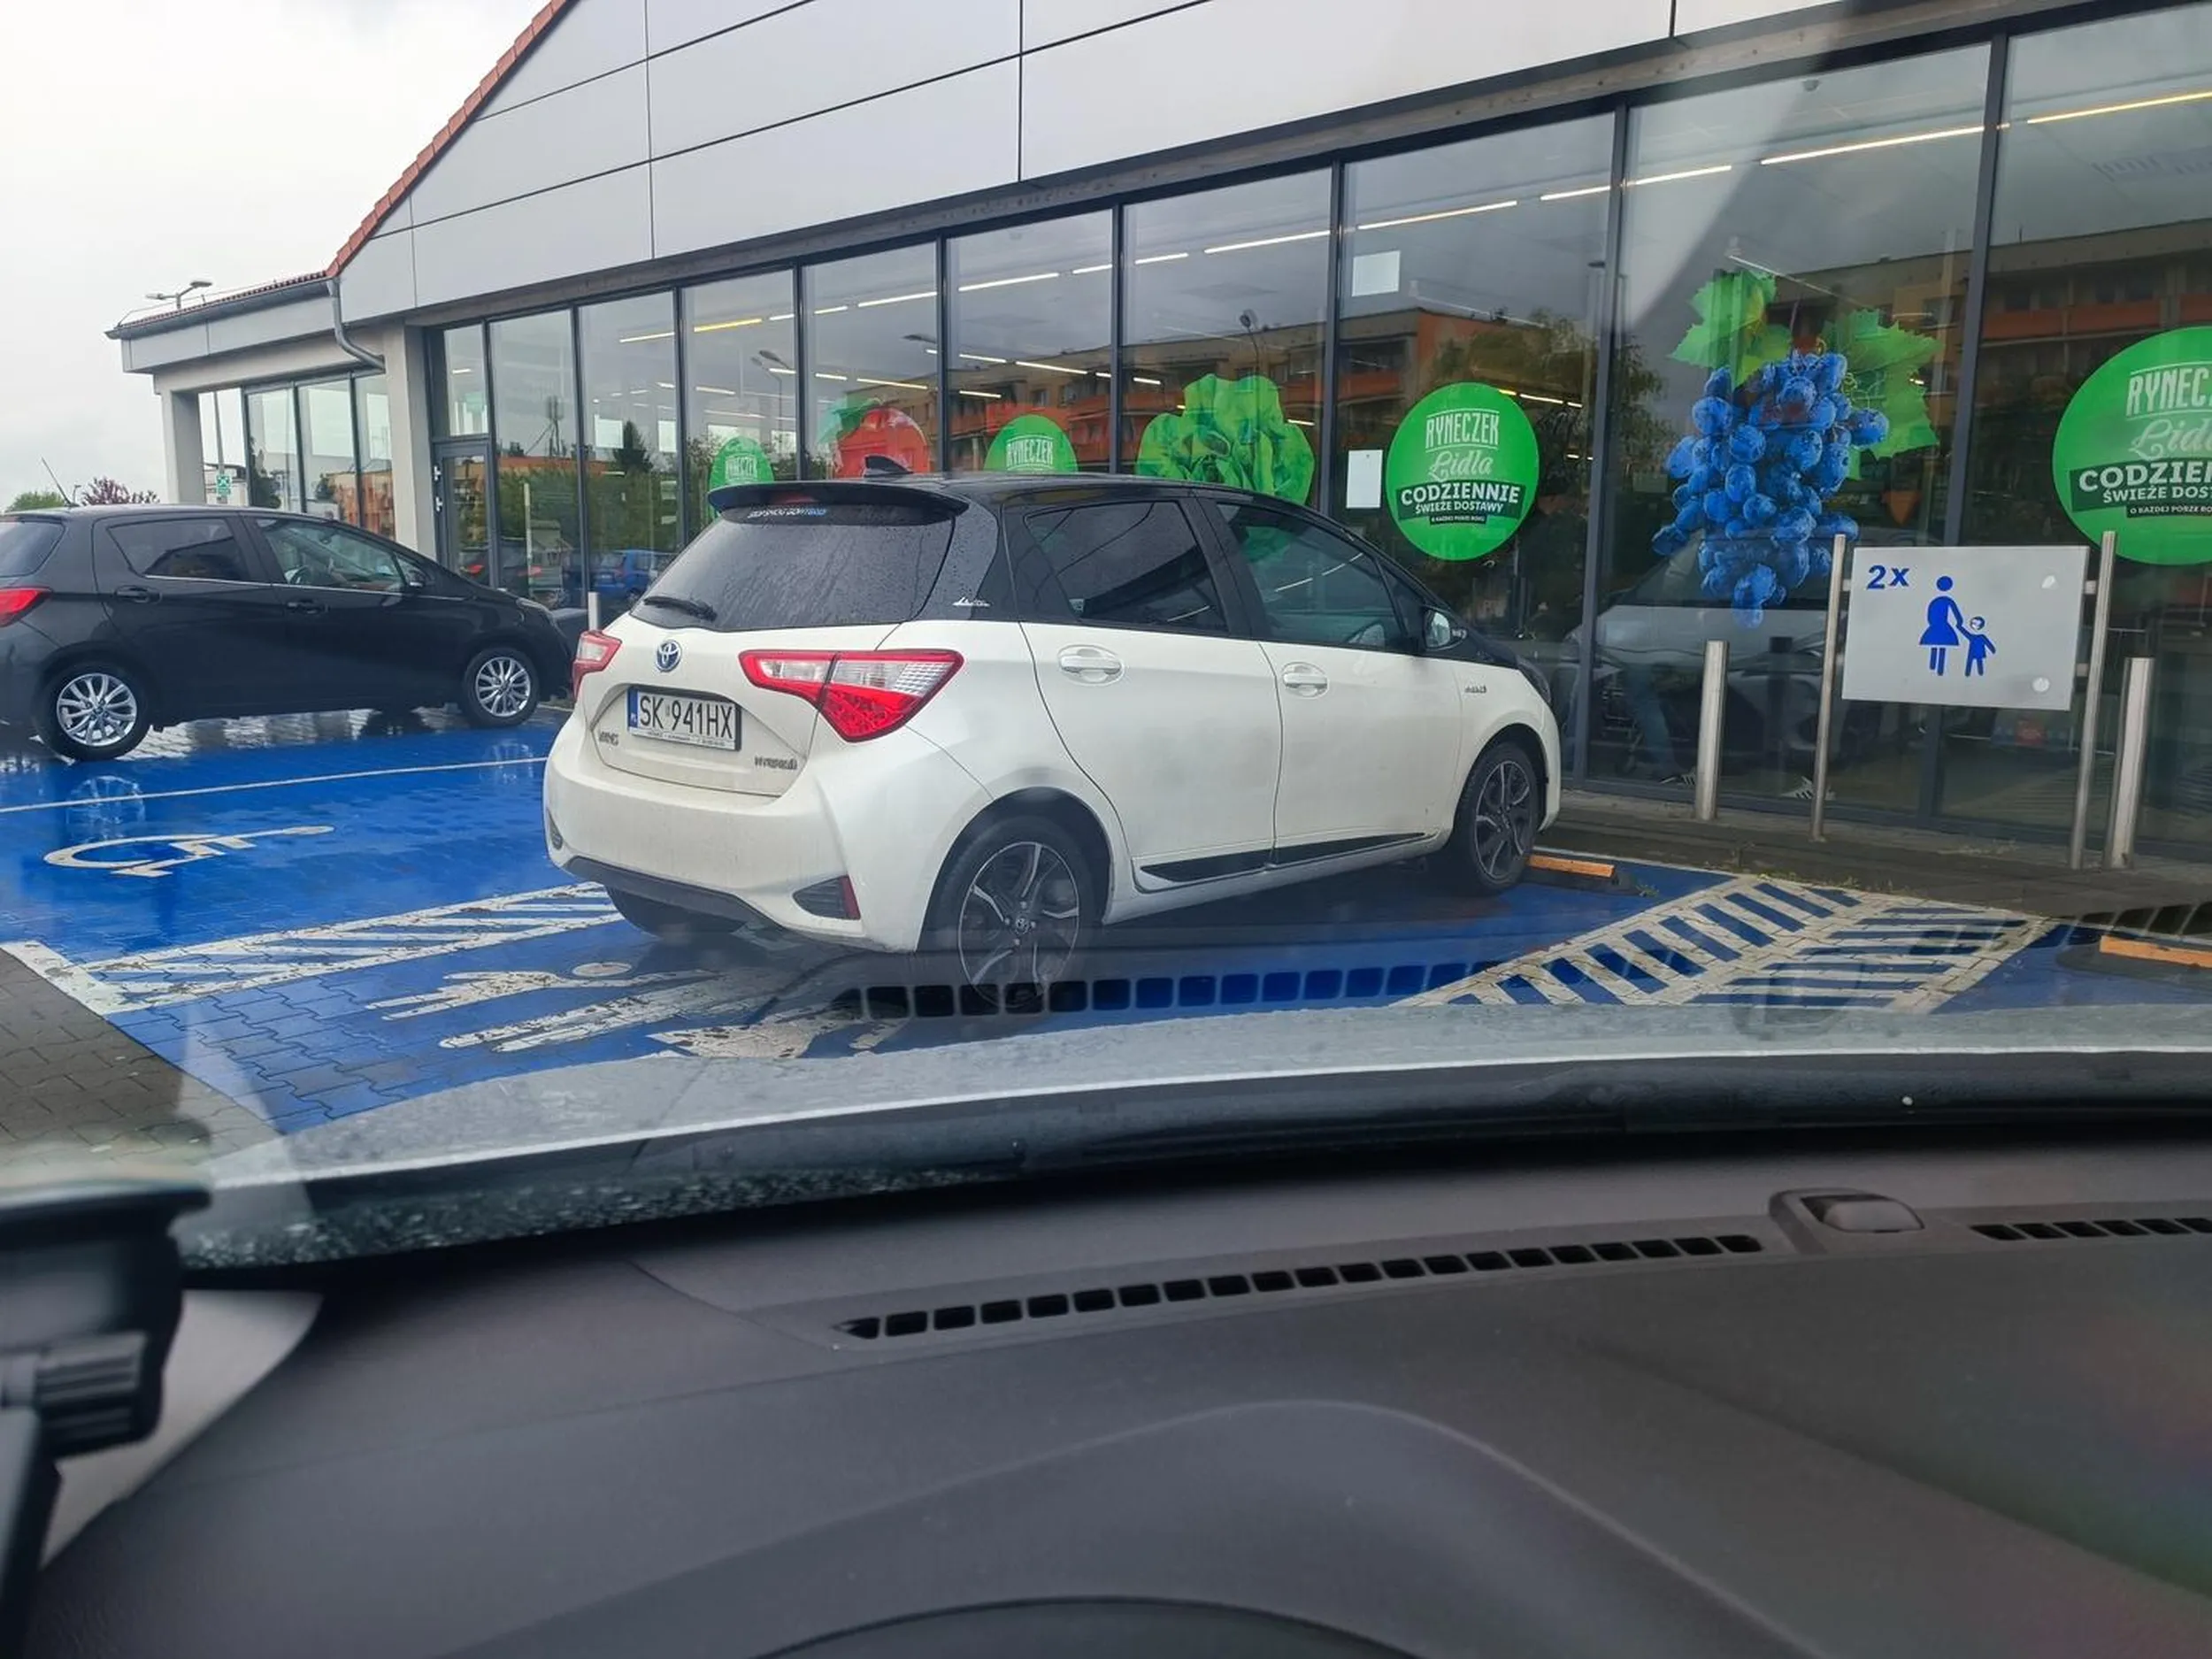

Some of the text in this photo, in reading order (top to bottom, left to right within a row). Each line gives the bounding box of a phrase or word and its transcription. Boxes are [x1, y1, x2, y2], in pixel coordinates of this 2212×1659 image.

[2126, 367, 2212, 417] RYNEC
[1425, 412, 1500, 449] RYNECZEK
[2128, 419, 2212, 460] Lid
[1428, 449, 1494, 482] Lidla
[1401, 482, 1520, 505] CODZIENNIE
[1454, 501, 1503, 512] DOSTAWY
[2102, 485, 2212, 503] ŚWIEŻE DOS
[640, 695, 664, 729] SK
[672, 700, 733, 739] 941HX
